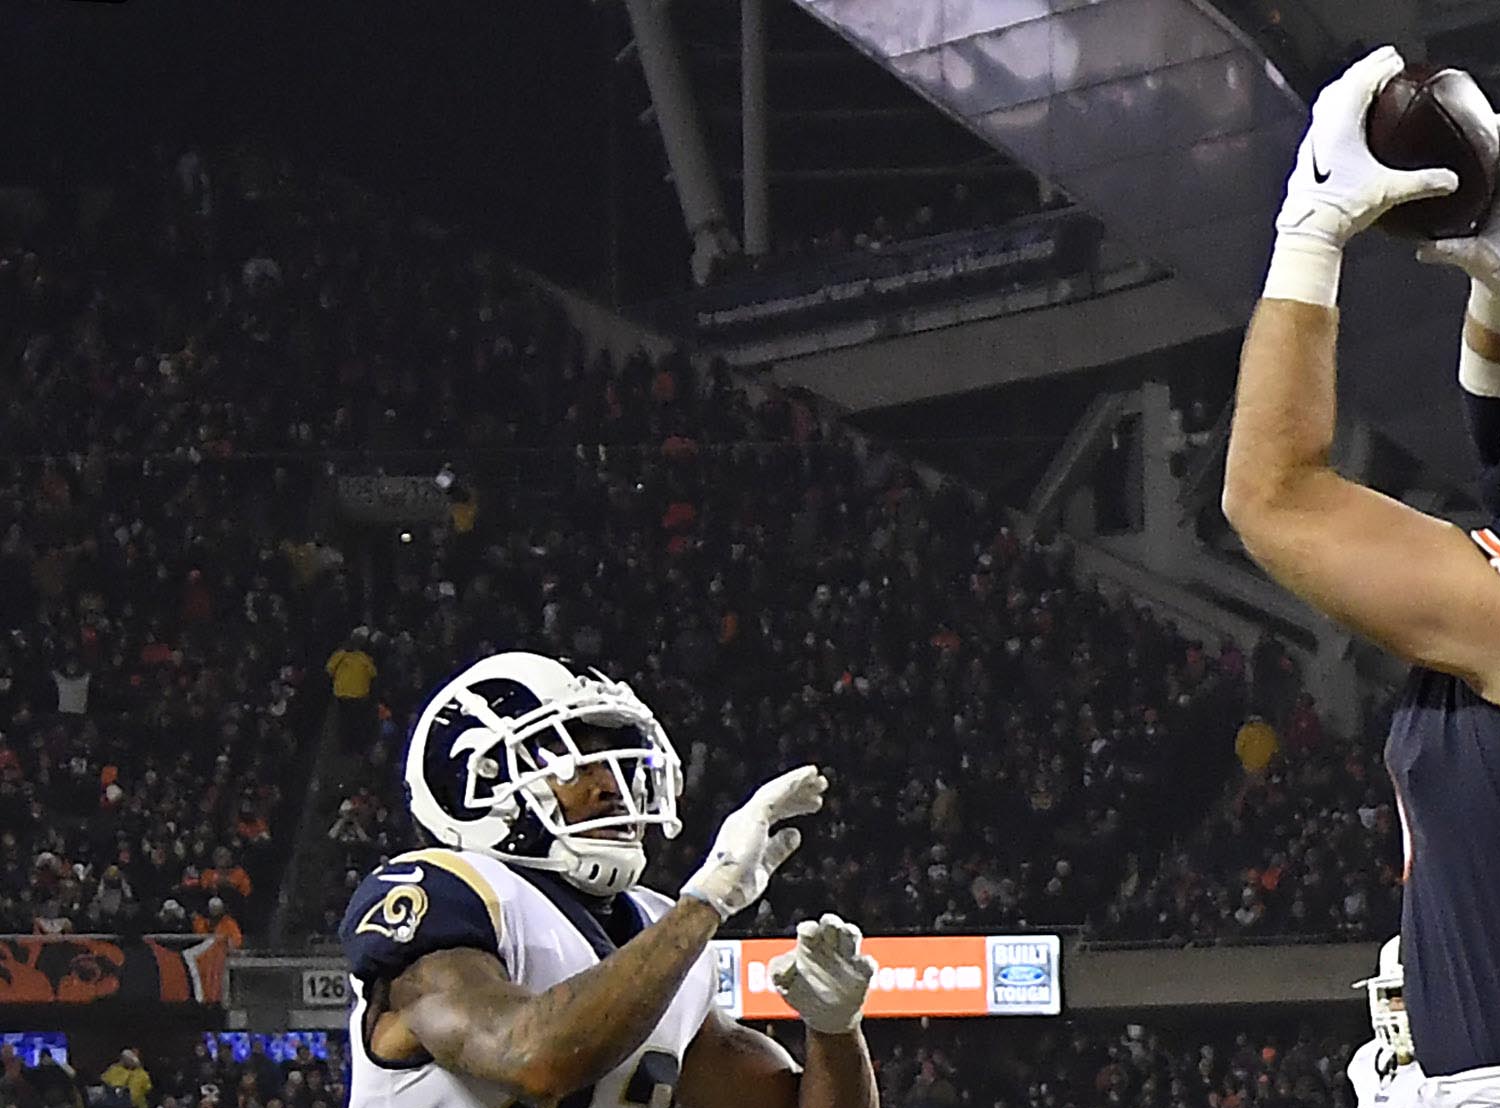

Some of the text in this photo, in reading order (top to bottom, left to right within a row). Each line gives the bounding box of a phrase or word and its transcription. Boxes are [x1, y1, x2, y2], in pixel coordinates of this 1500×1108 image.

[994, 944, 1048, 965] BUILT
[309, 976, 345, 998] 126
[994, 986, 1050, 1002] TOUGH
